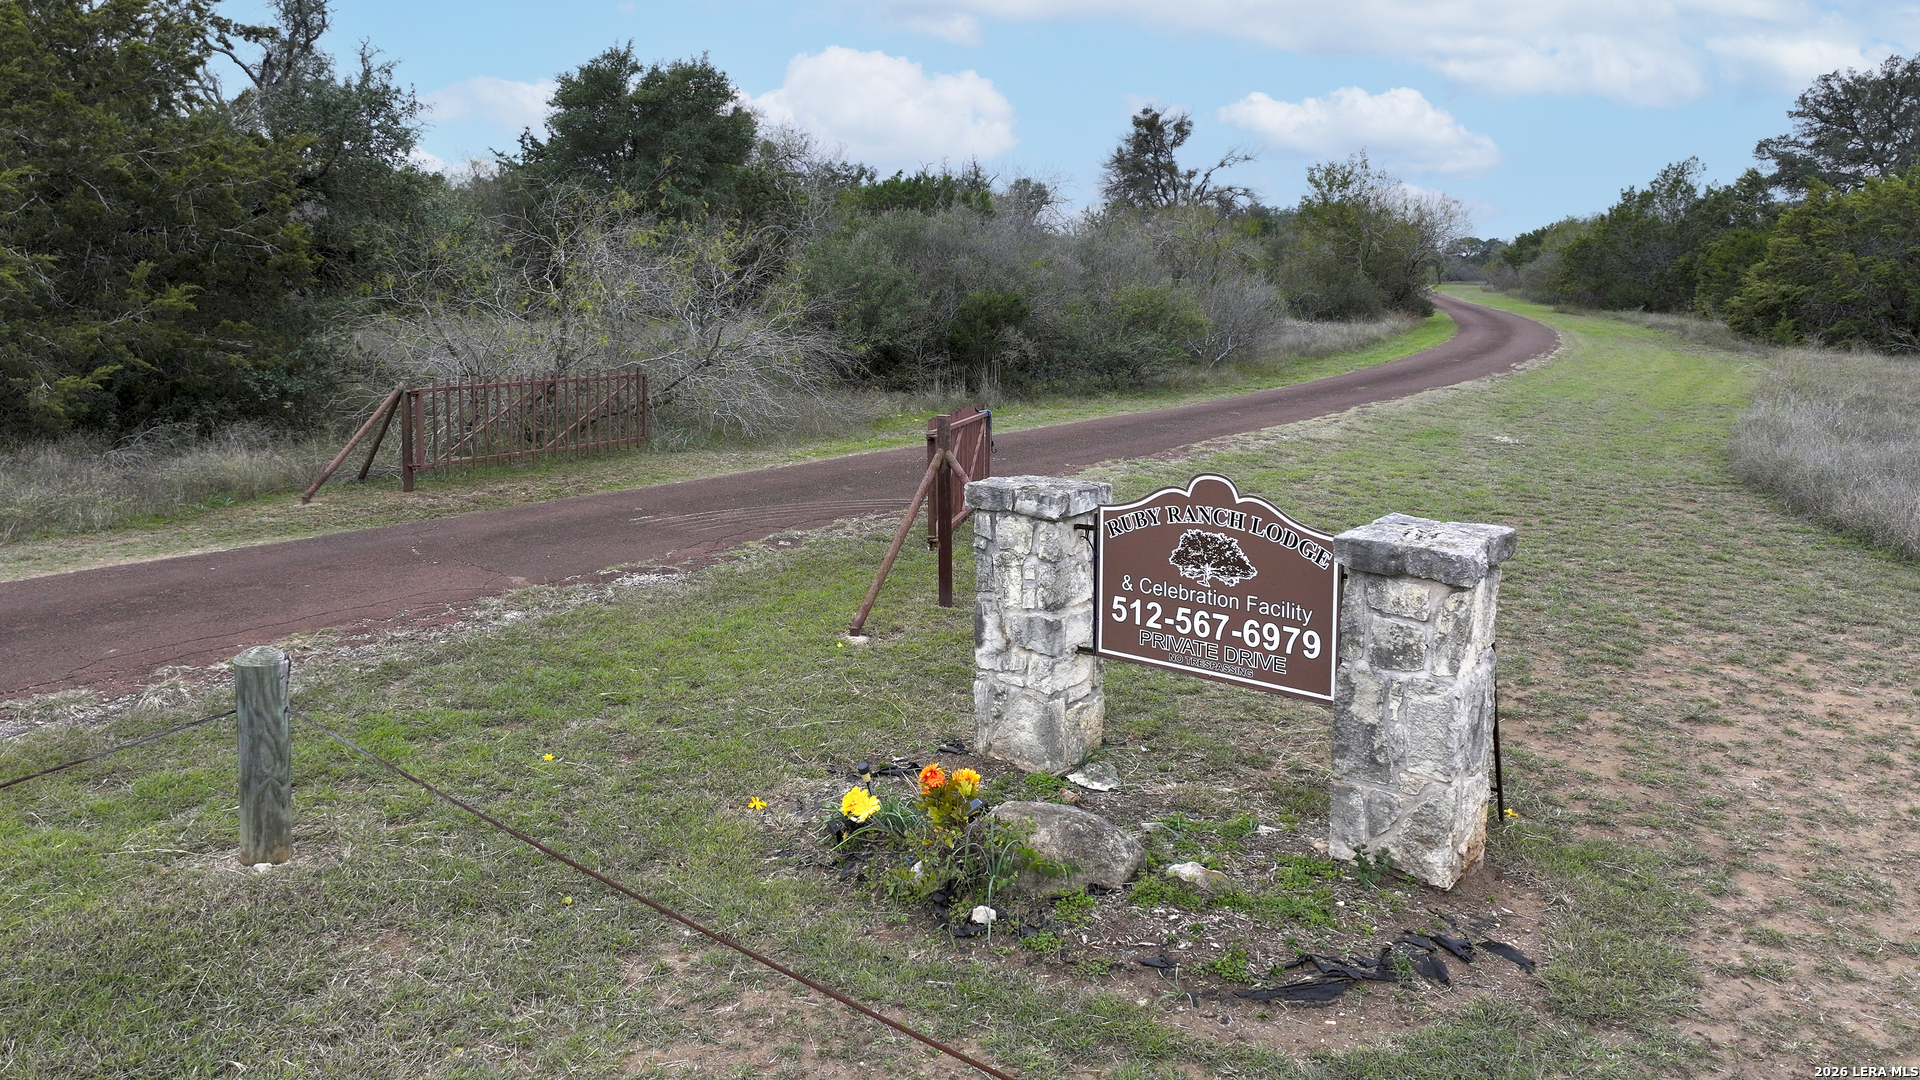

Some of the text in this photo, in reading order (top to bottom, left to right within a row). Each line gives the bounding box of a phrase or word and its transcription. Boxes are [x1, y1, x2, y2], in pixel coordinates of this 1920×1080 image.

[1105, 505, 1333, 570] RUBY RANCH LODGE
[1122, 574, 1313, 626] & Celebration Facility
[1111, 595, 1321, 660] 512-567-6979
[1139, 630, 1287, 674] PRIVATE DRIVE
[1169, 653, 1254, 678] NO TRESPASSING
